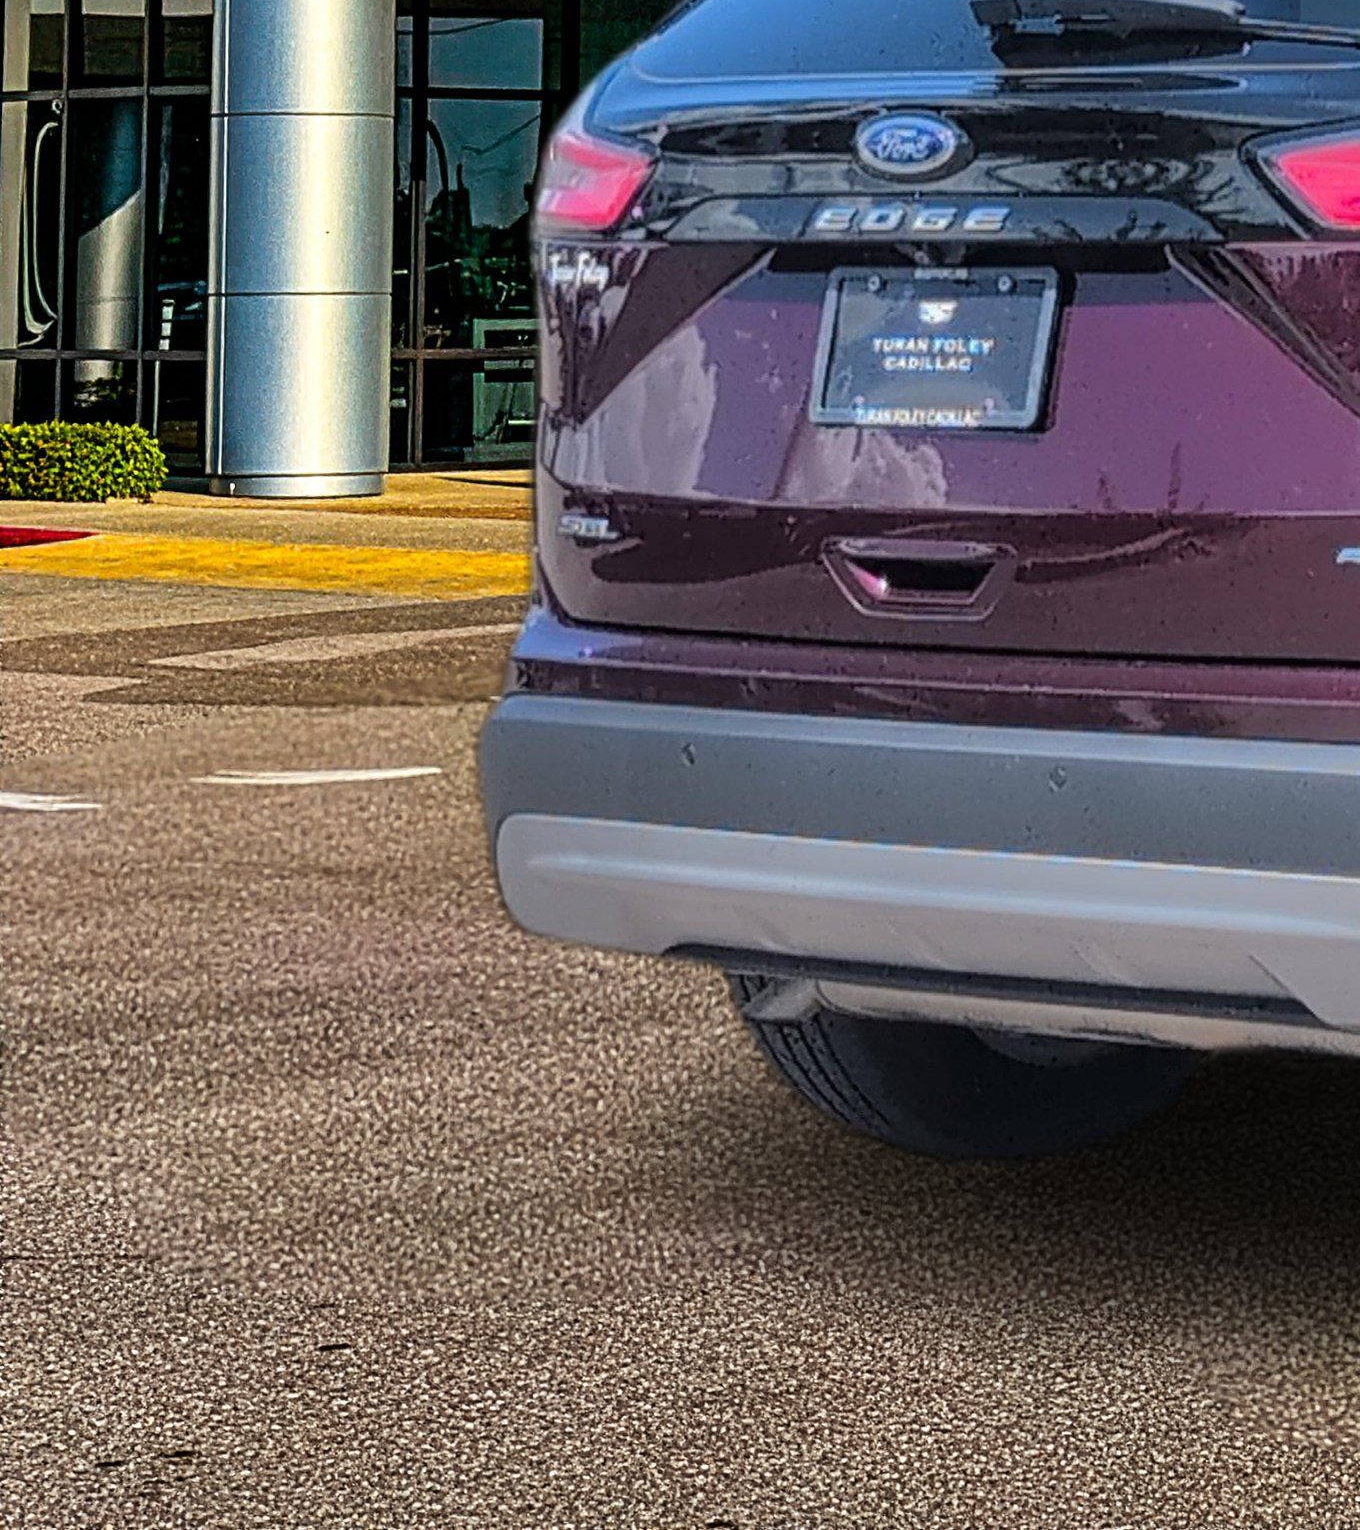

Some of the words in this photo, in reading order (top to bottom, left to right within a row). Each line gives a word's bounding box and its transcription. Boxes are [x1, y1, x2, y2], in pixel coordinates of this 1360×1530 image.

[876, 128, 932, 160] Ford
[814, 206, 1011, 231] EDGE
[873, 336, 928, 353] TURAN
[930, 336, 995, 355] FOLEY
[882, 355, 973, 372] CADILLAC
